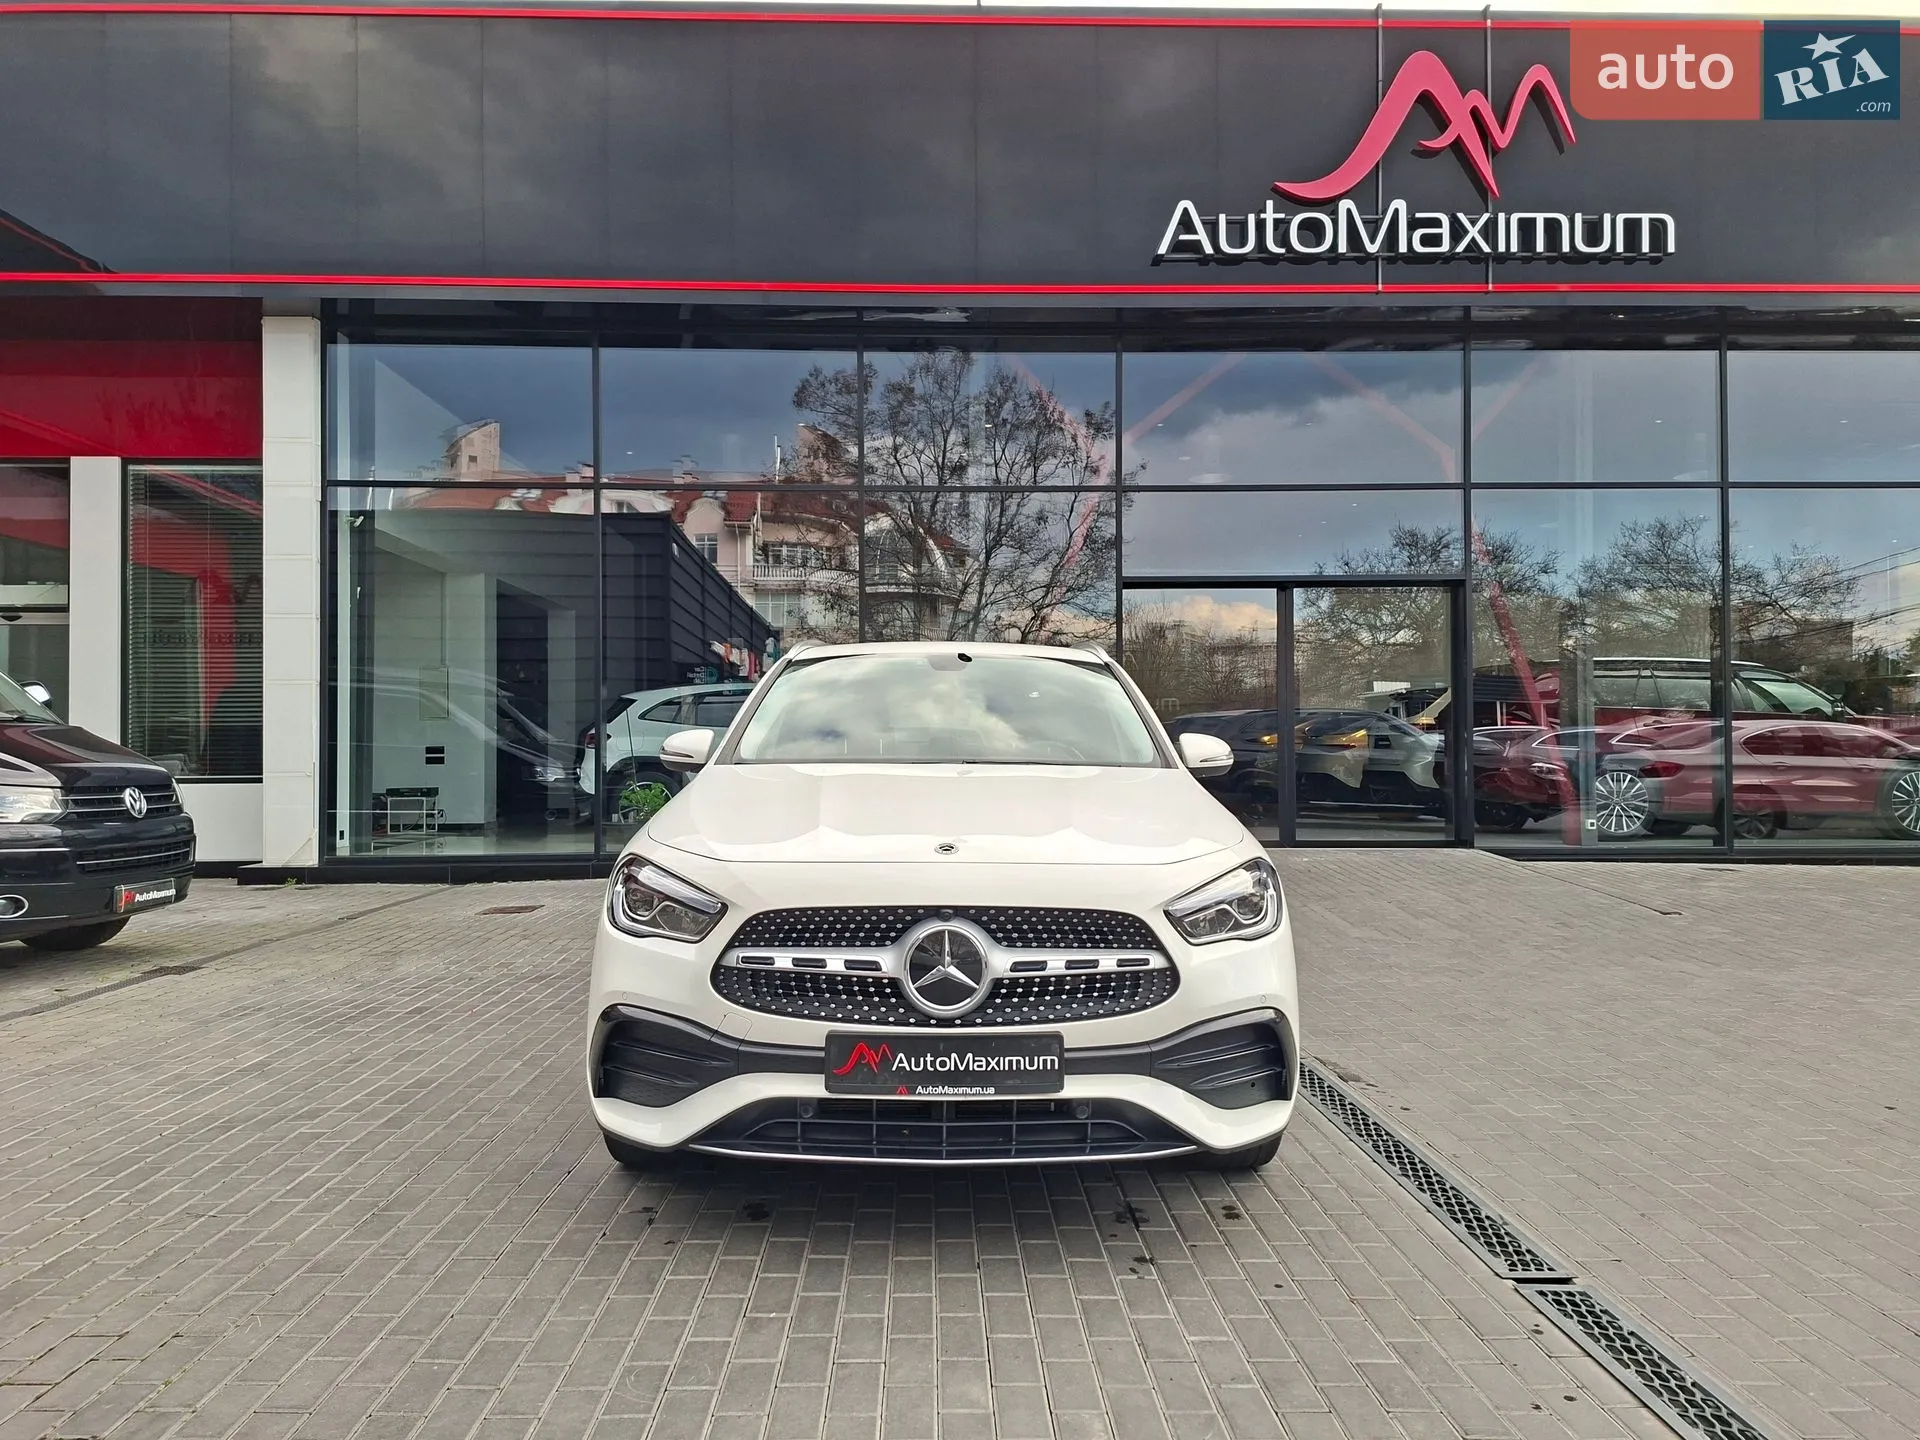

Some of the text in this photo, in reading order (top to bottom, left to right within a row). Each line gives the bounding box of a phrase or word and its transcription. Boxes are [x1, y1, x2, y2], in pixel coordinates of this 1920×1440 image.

[1156, 199, 1676, 256] AutoMaximum
[891, 1052, 1060, 1072] AutoMaximum
[915, 1085, 995, 1095] AutoMaximum.ua
